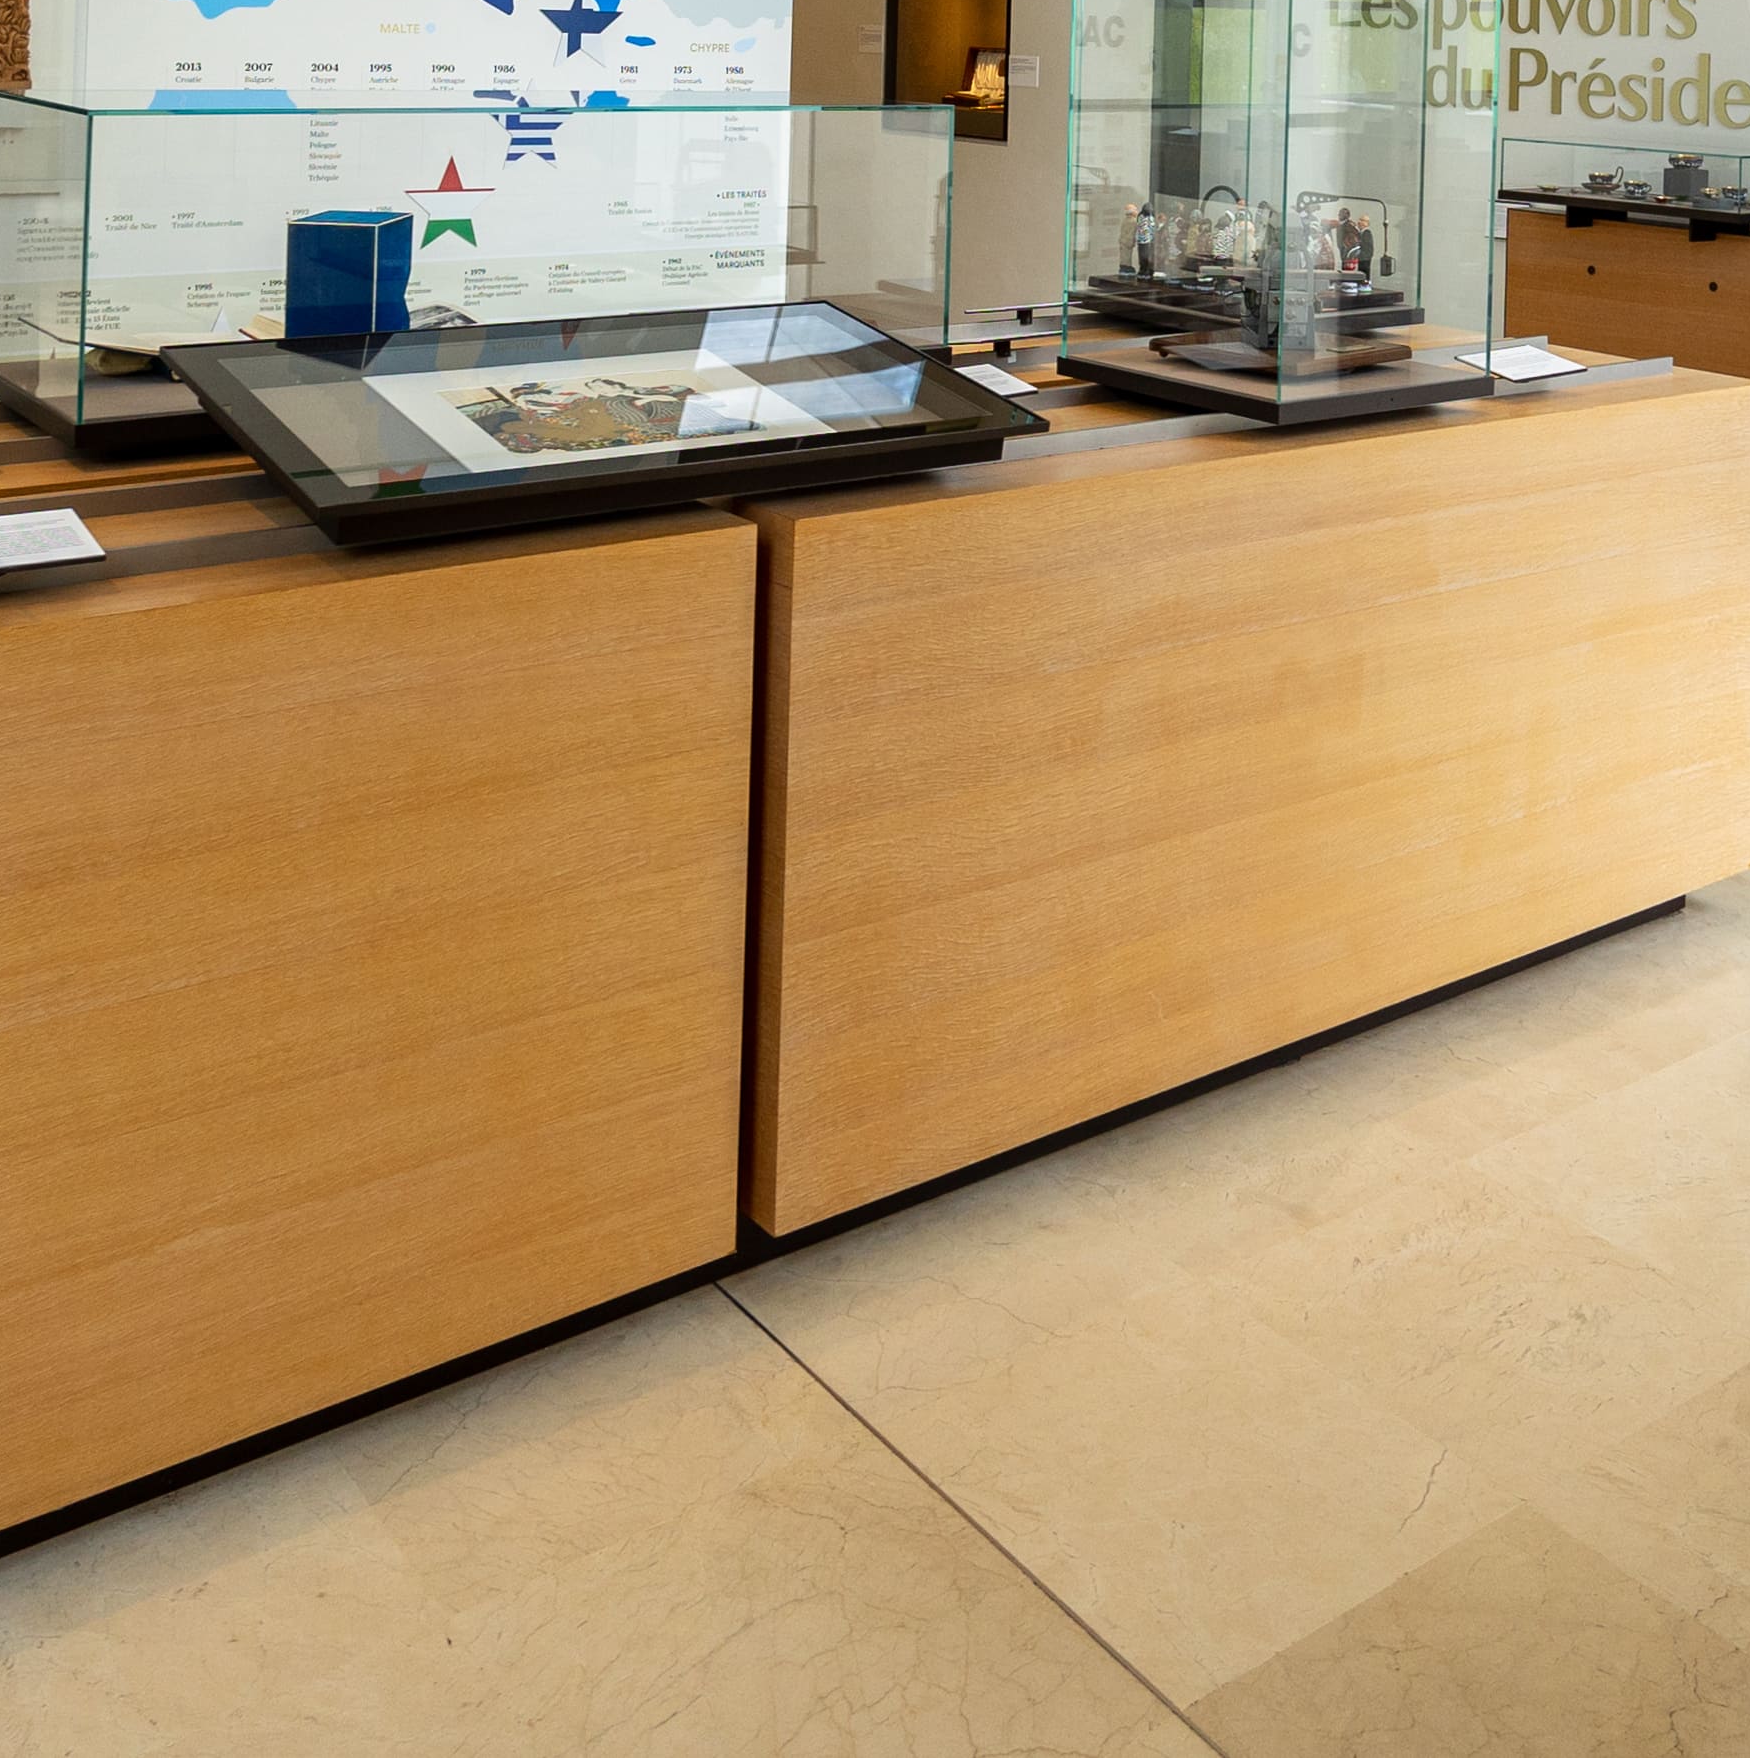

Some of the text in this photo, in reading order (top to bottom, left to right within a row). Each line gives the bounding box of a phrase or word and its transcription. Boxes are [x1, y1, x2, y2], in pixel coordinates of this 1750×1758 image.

[380, 23, 420, 35] MALTE
[690, 43, 730, 54] CHYPRE
[175, 62, 202, 72] 2013
[244, 63, 273, 72] 2007
[311, 63, 339, 72] 2004
[369, 64, 392, 72] 1995
[431, 64, 455, 73] 1990
[493, 64, 515, 74] 1986
[620, 65, 638, 74] 1981
[673, 65, 692, 74] 1973
[1426, 45, 1494, 110] du
[722, 191, 735, 199] LES
[716, 259, 765, 269] MARQUANTS
